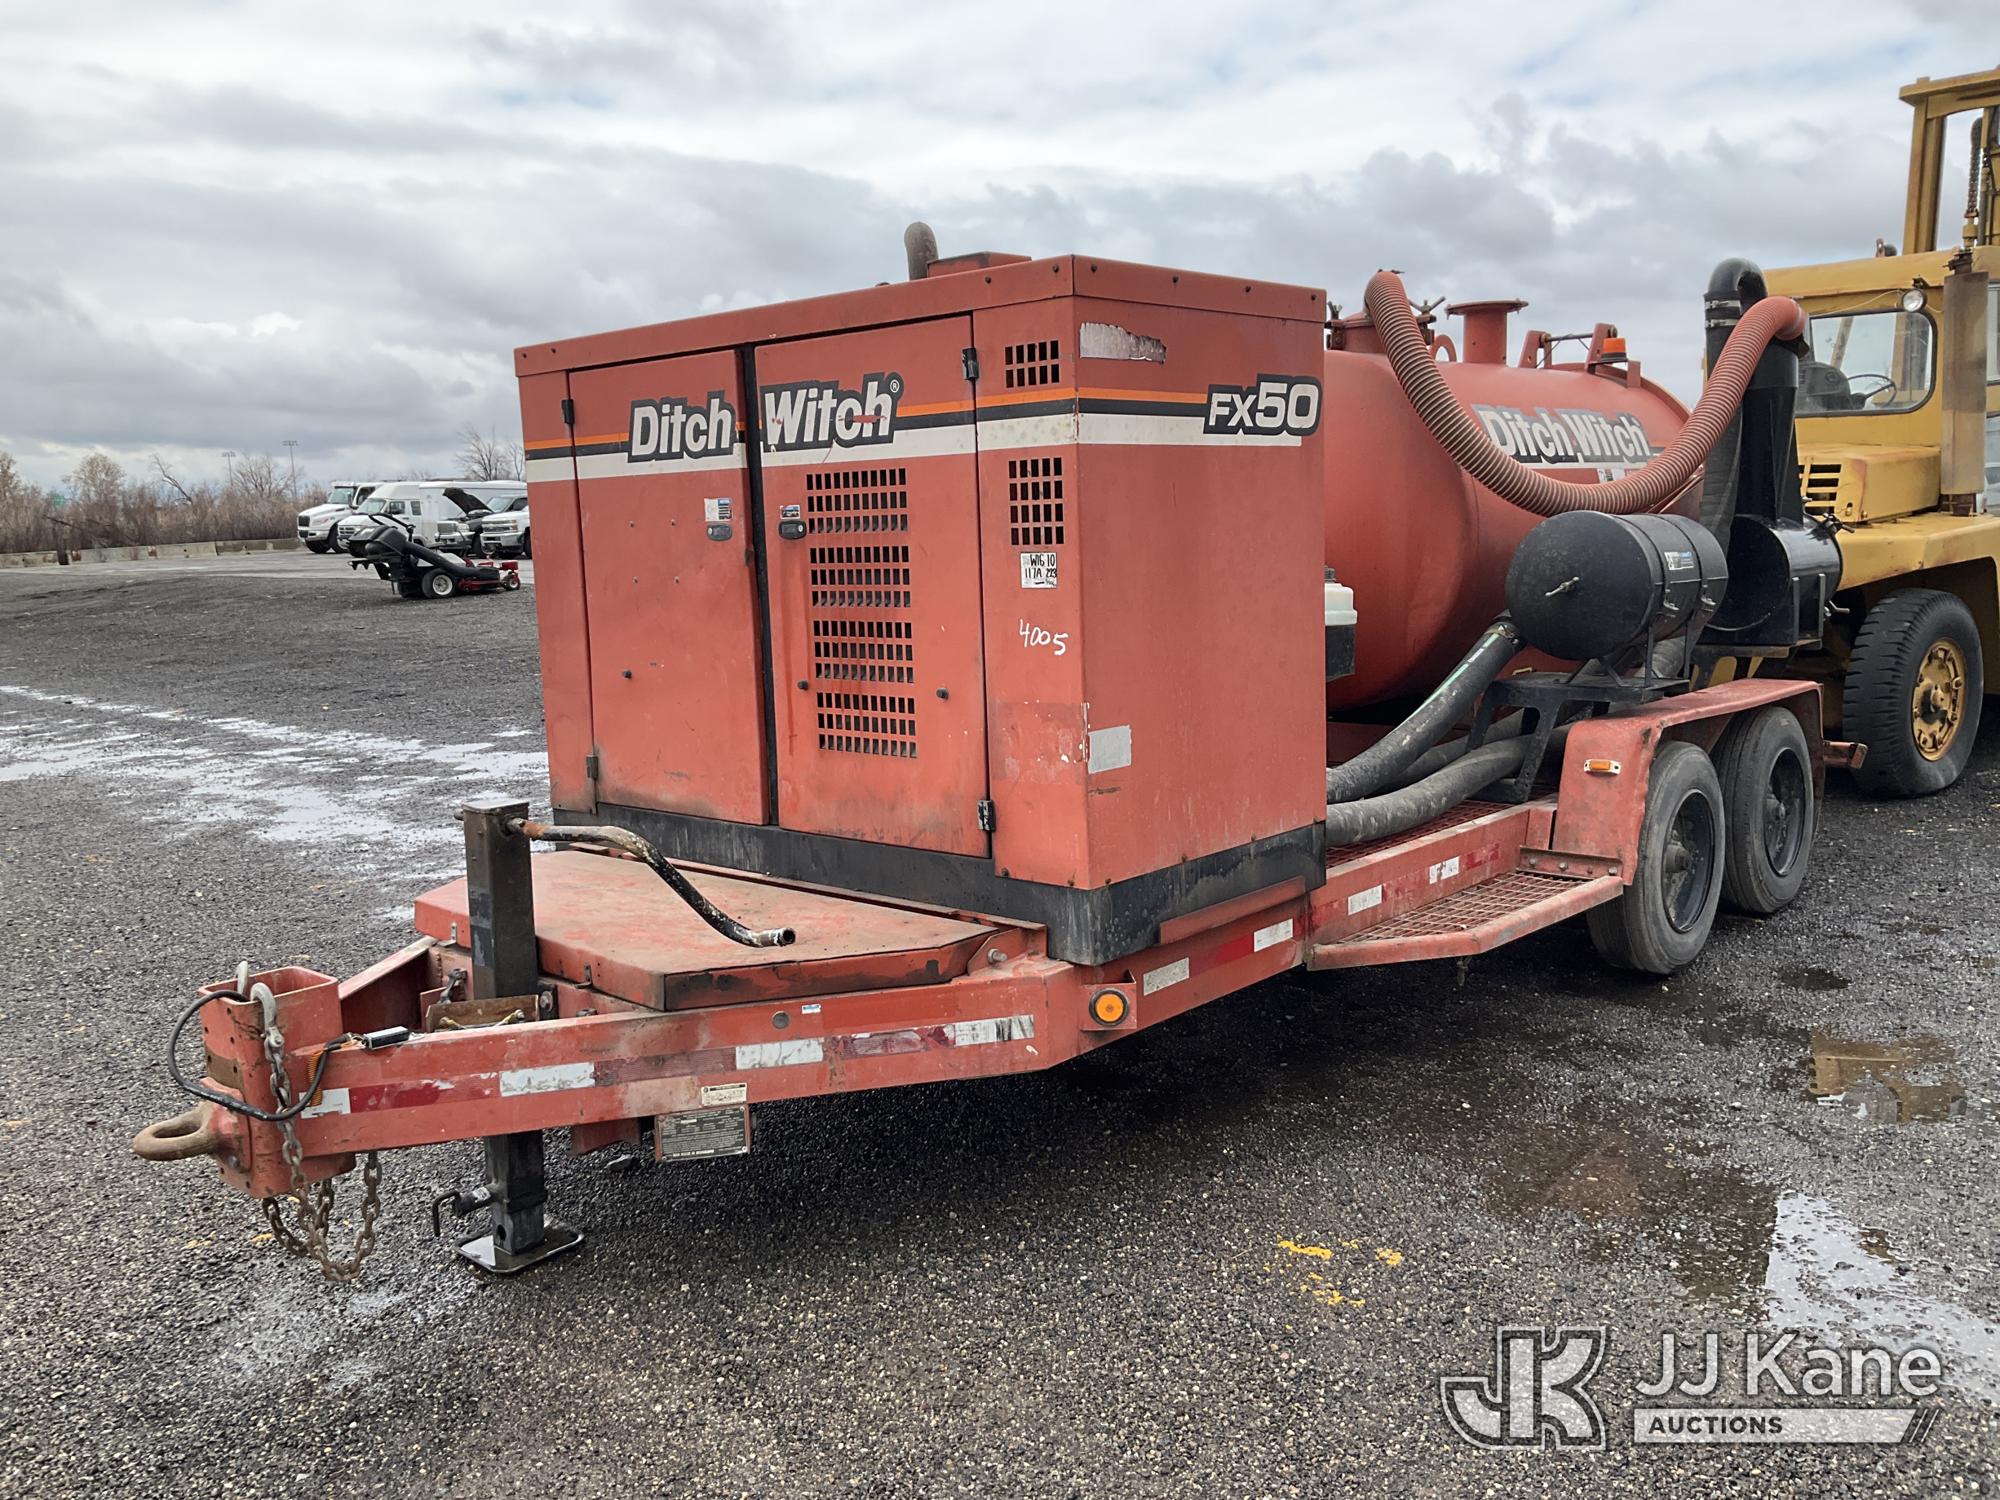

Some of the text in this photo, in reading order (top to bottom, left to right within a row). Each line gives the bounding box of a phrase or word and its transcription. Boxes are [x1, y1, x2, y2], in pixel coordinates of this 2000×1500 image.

[631, 398, 732, 456] Ditch
[1208, 381, 1319, 429] FX50
[1478, 409, 1574, 457] Ditch
[1020, 619, 1069, 656] 4005
